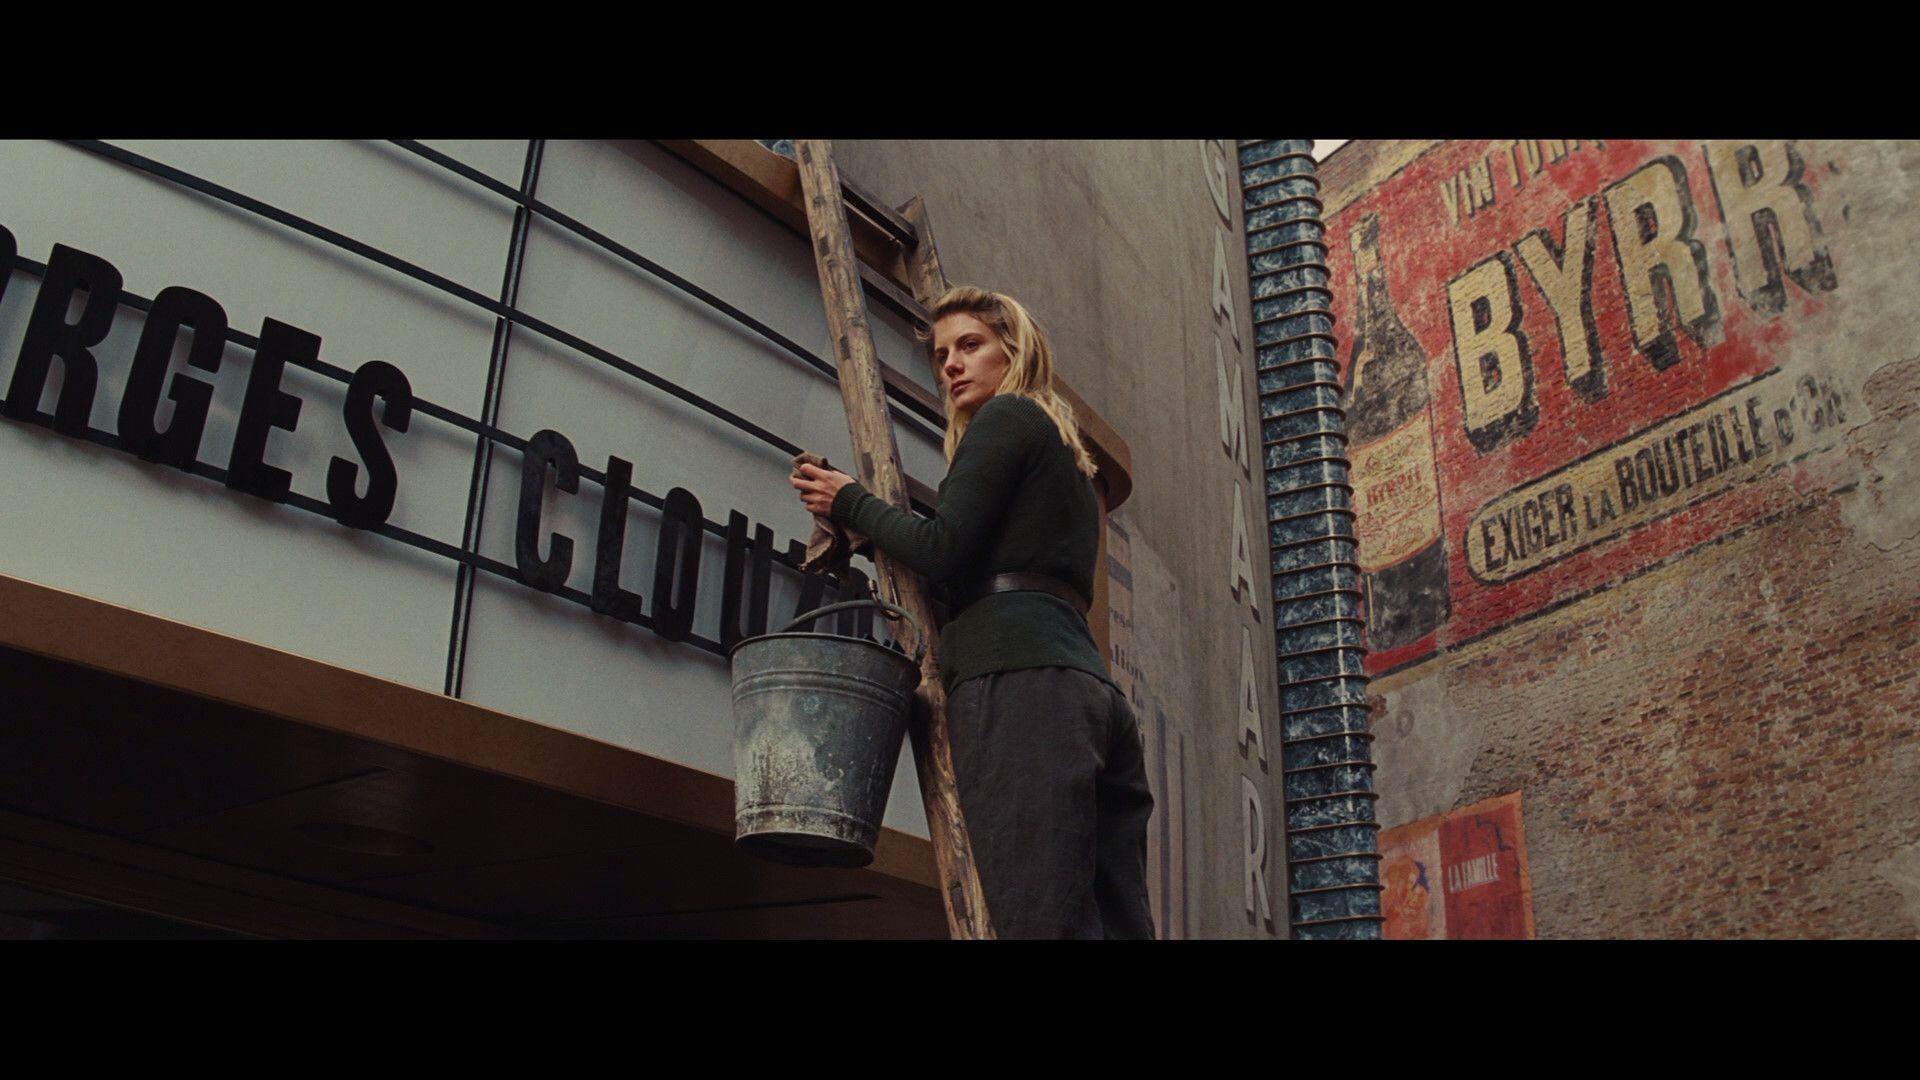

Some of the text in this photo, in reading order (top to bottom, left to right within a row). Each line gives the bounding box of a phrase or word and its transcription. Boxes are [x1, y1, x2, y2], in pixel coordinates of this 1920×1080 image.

[1440, 154, 1496, 226] VIN
[0, 223, 415, 531] RGES
[1480, 483, 1578, 572] EXIGER
[1583, 488, 1616, 530] LA
[1614, 396, 1773, 514] BOUTEILLE
